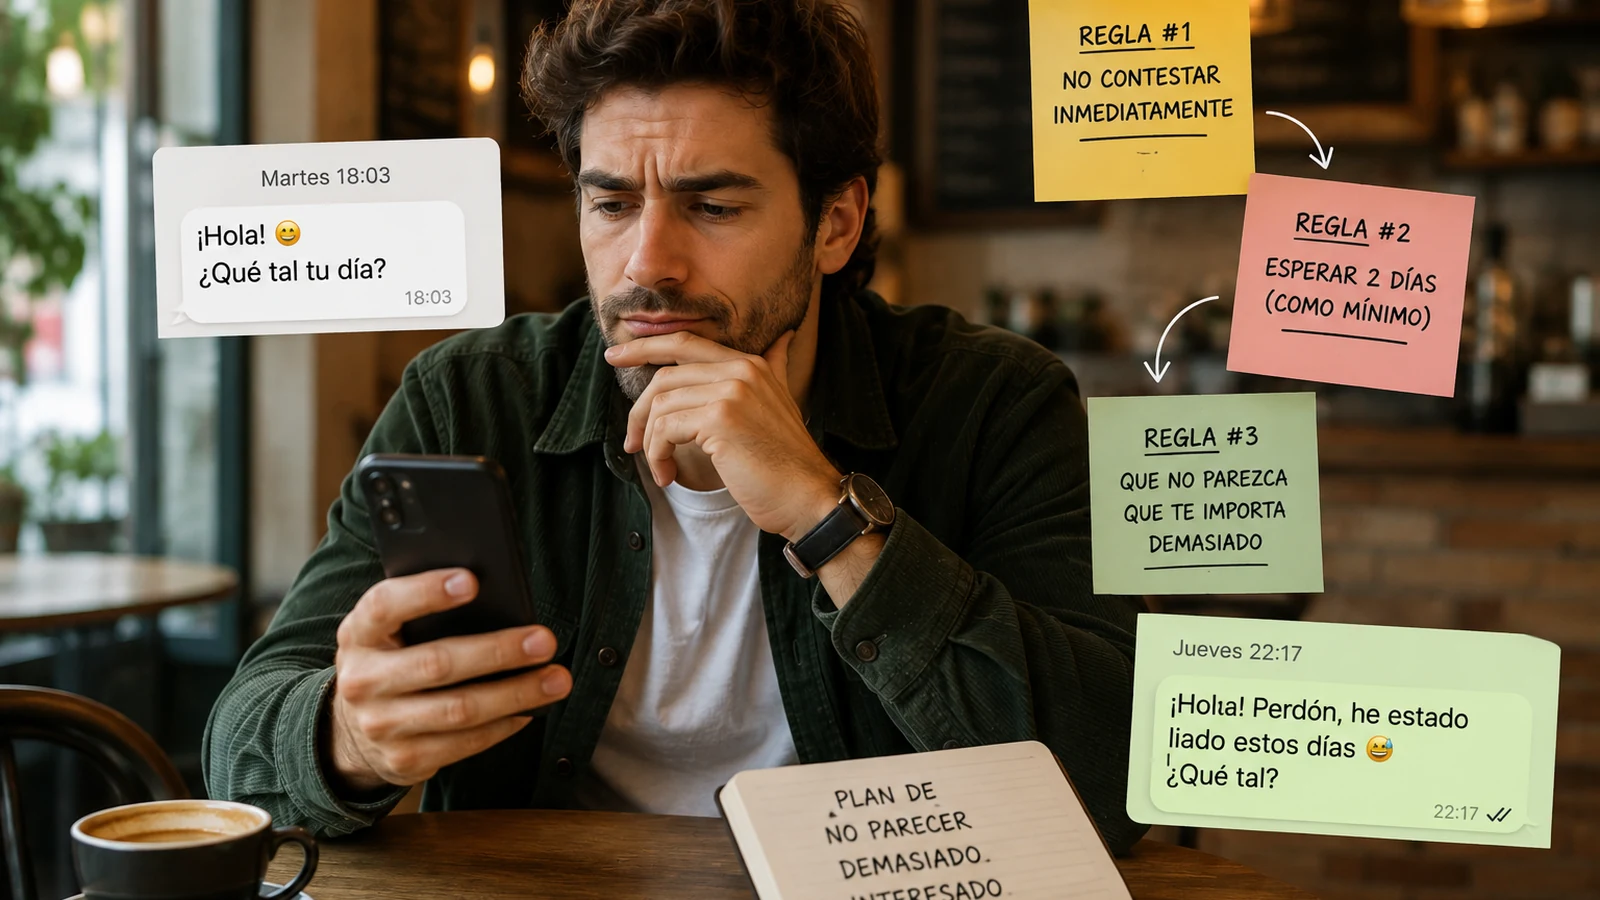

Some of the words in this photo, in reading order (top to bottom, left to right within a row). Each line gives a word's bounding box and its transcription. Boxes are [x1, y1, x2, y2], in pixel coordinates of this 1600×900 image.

[1079, 23, 1152, 47] REGLA
[1161, 21, 1190, 42] #1
[1063, 70, 1092, 90] NO
[1100, 64, 1221, 89] CONTESTAR
[1054, 97, 1234, 125] INMEDIATAMENTE
[1294, 210, 1368, 239] REGLA
[1378, 221, 1411, 243] #2
[1265, 257, 1358, 286] ESPERAR
[1366, 268, 1380, 288] 2
[1390, 266, 1437, 294] DÍAS
[1265, 287, 1334, 318] (COMO
[1342, 297, 1431, 332] MÍNIMO)
[1144, 426, 1217, 449] REGLA
[1226, 425, 1259, 446] #3
[1119, 471, 1160, 492] QUE
[1168, 471, 1195, 489] NO
[1203, 468, 1288, 489] PAREZCA
[1123, 503, 1164, 525] QUE
[1170, 502, 1195, 521] TE
[1203, 500, 1286, 521] IMPORTA
[1148, 532, 1263, 554] DEMASIADO
[834, 786, 896, 809] PLAN
[904, 781, 937, 803] DE
[824, 824, 858, 845] NO
[867, 810, 973, 840] PARECER
